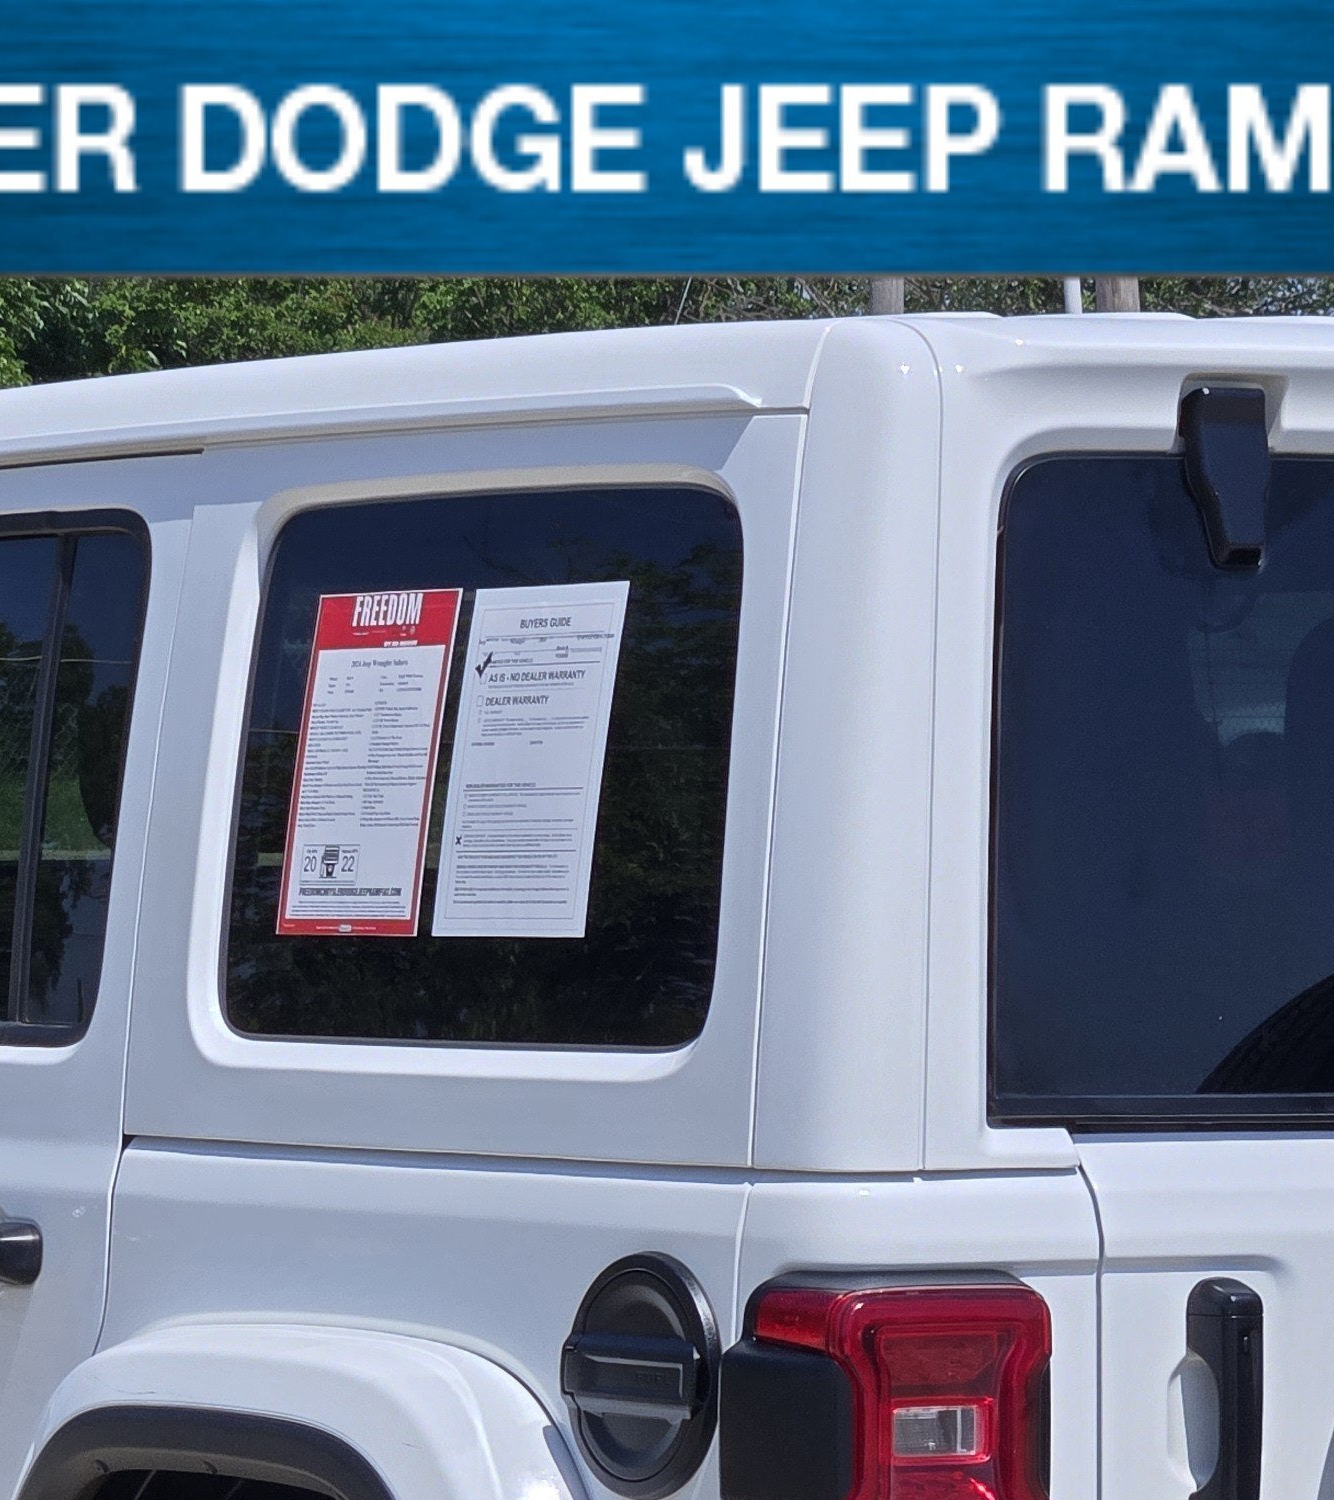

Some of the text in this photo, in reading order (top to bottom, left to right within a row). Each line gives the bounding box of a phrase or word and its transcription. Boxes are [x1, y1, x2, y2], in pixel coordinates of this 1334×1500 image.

[351, 593, 424, 627] FREEDOM
[520, 617, 572, 629] BUYERS GUIDE
[488, 673, 498, 683] AS
[510, 672, 521, 682] NO
[521, 671, 547, 682] DEALER
[548, 669, 586, 681] WARRANTY
[485, 695, 549, 706] DEALER WARRANTY
[303, 855, 317, 872] 20
[340, 855, 355, 872] 22
